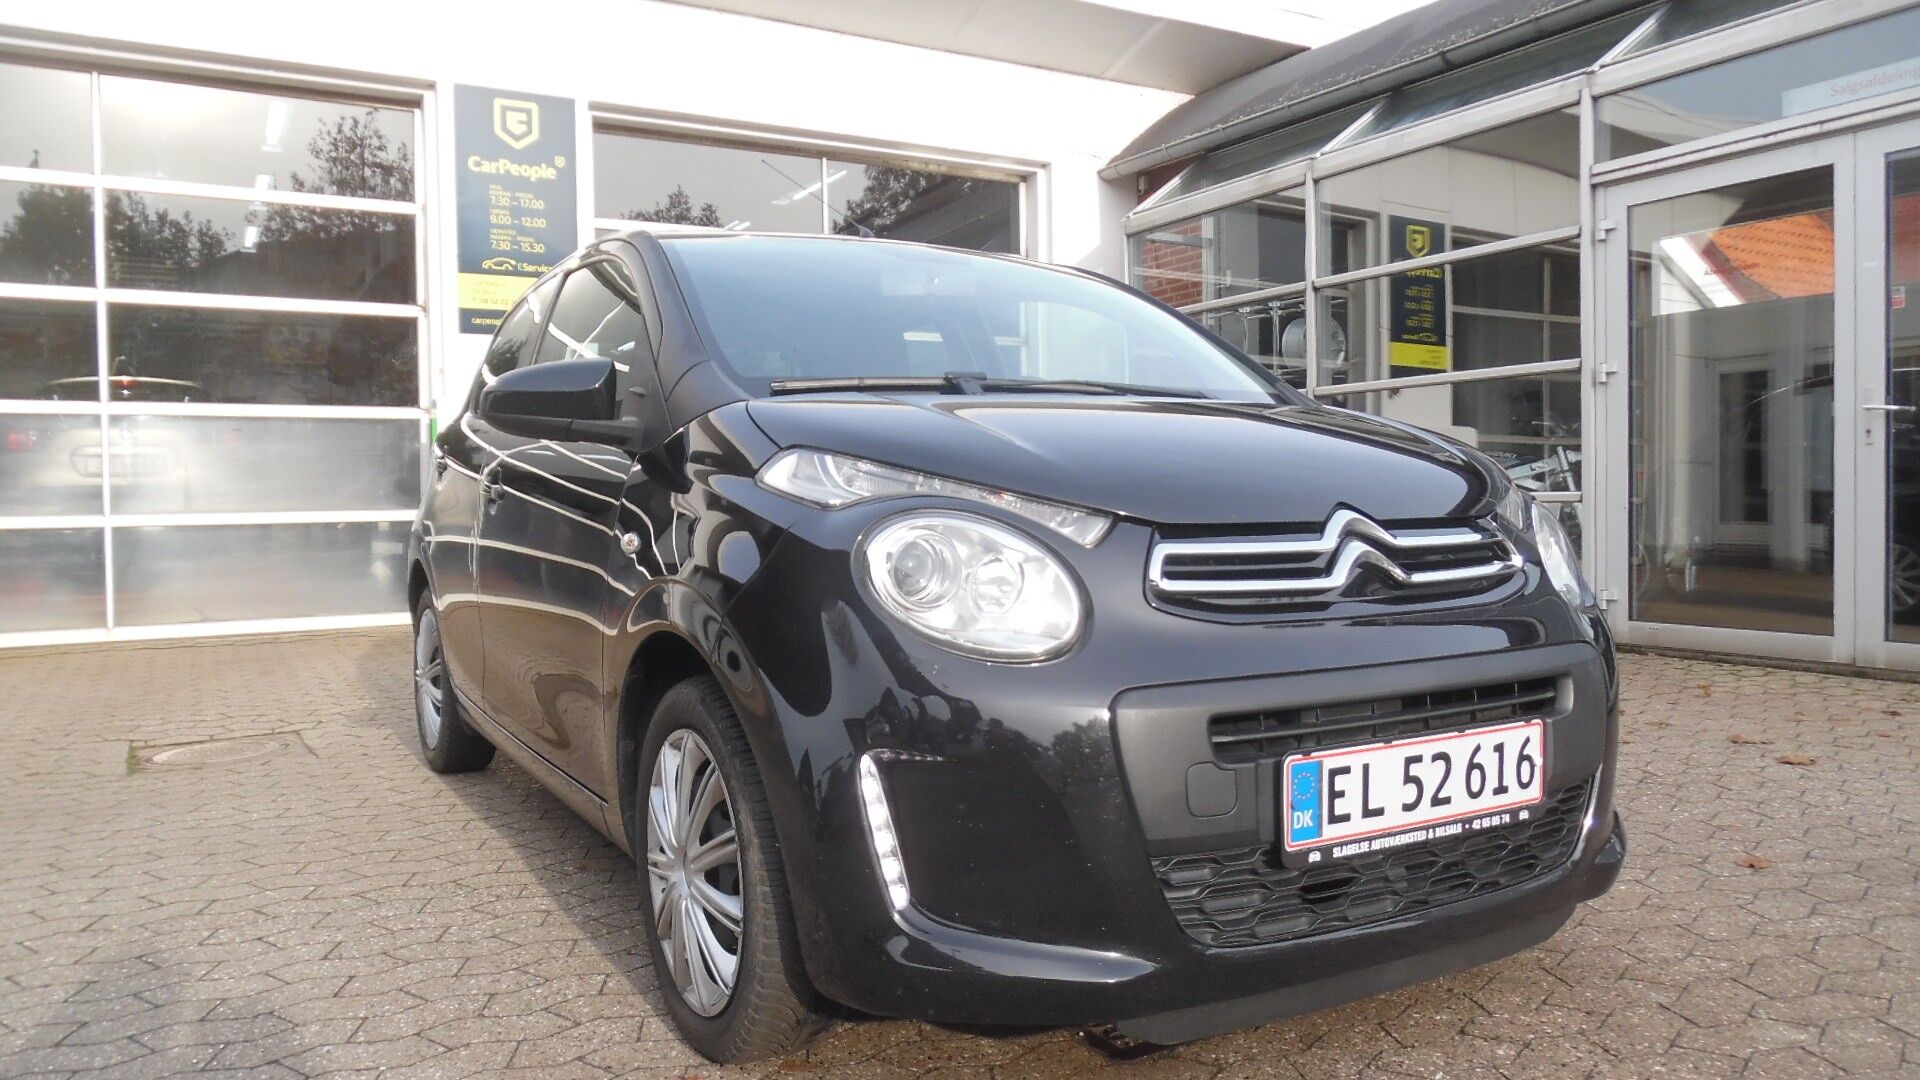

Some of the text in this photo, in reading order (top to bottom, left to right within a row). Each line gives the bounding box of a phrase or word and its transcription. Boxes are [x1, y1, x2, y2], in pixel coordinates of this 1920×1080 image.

[467, 155, 557, 181] CarPeople
[489, 195, 509, 206] 7.30
[520, 198, 544, 209] 17.00
[521, 217, 546, 228] 12.00
[490, 240, 510, 250] 7.30
[520, 242, 544, 253] 15.30
[1327, 735, 1535, 825] EL 52 616
[1293, 809, 1313, 829] DK
[1332, 841, 1370, 858] SLAGELSE
[1435, 823, 1462, 838] BILSALG
